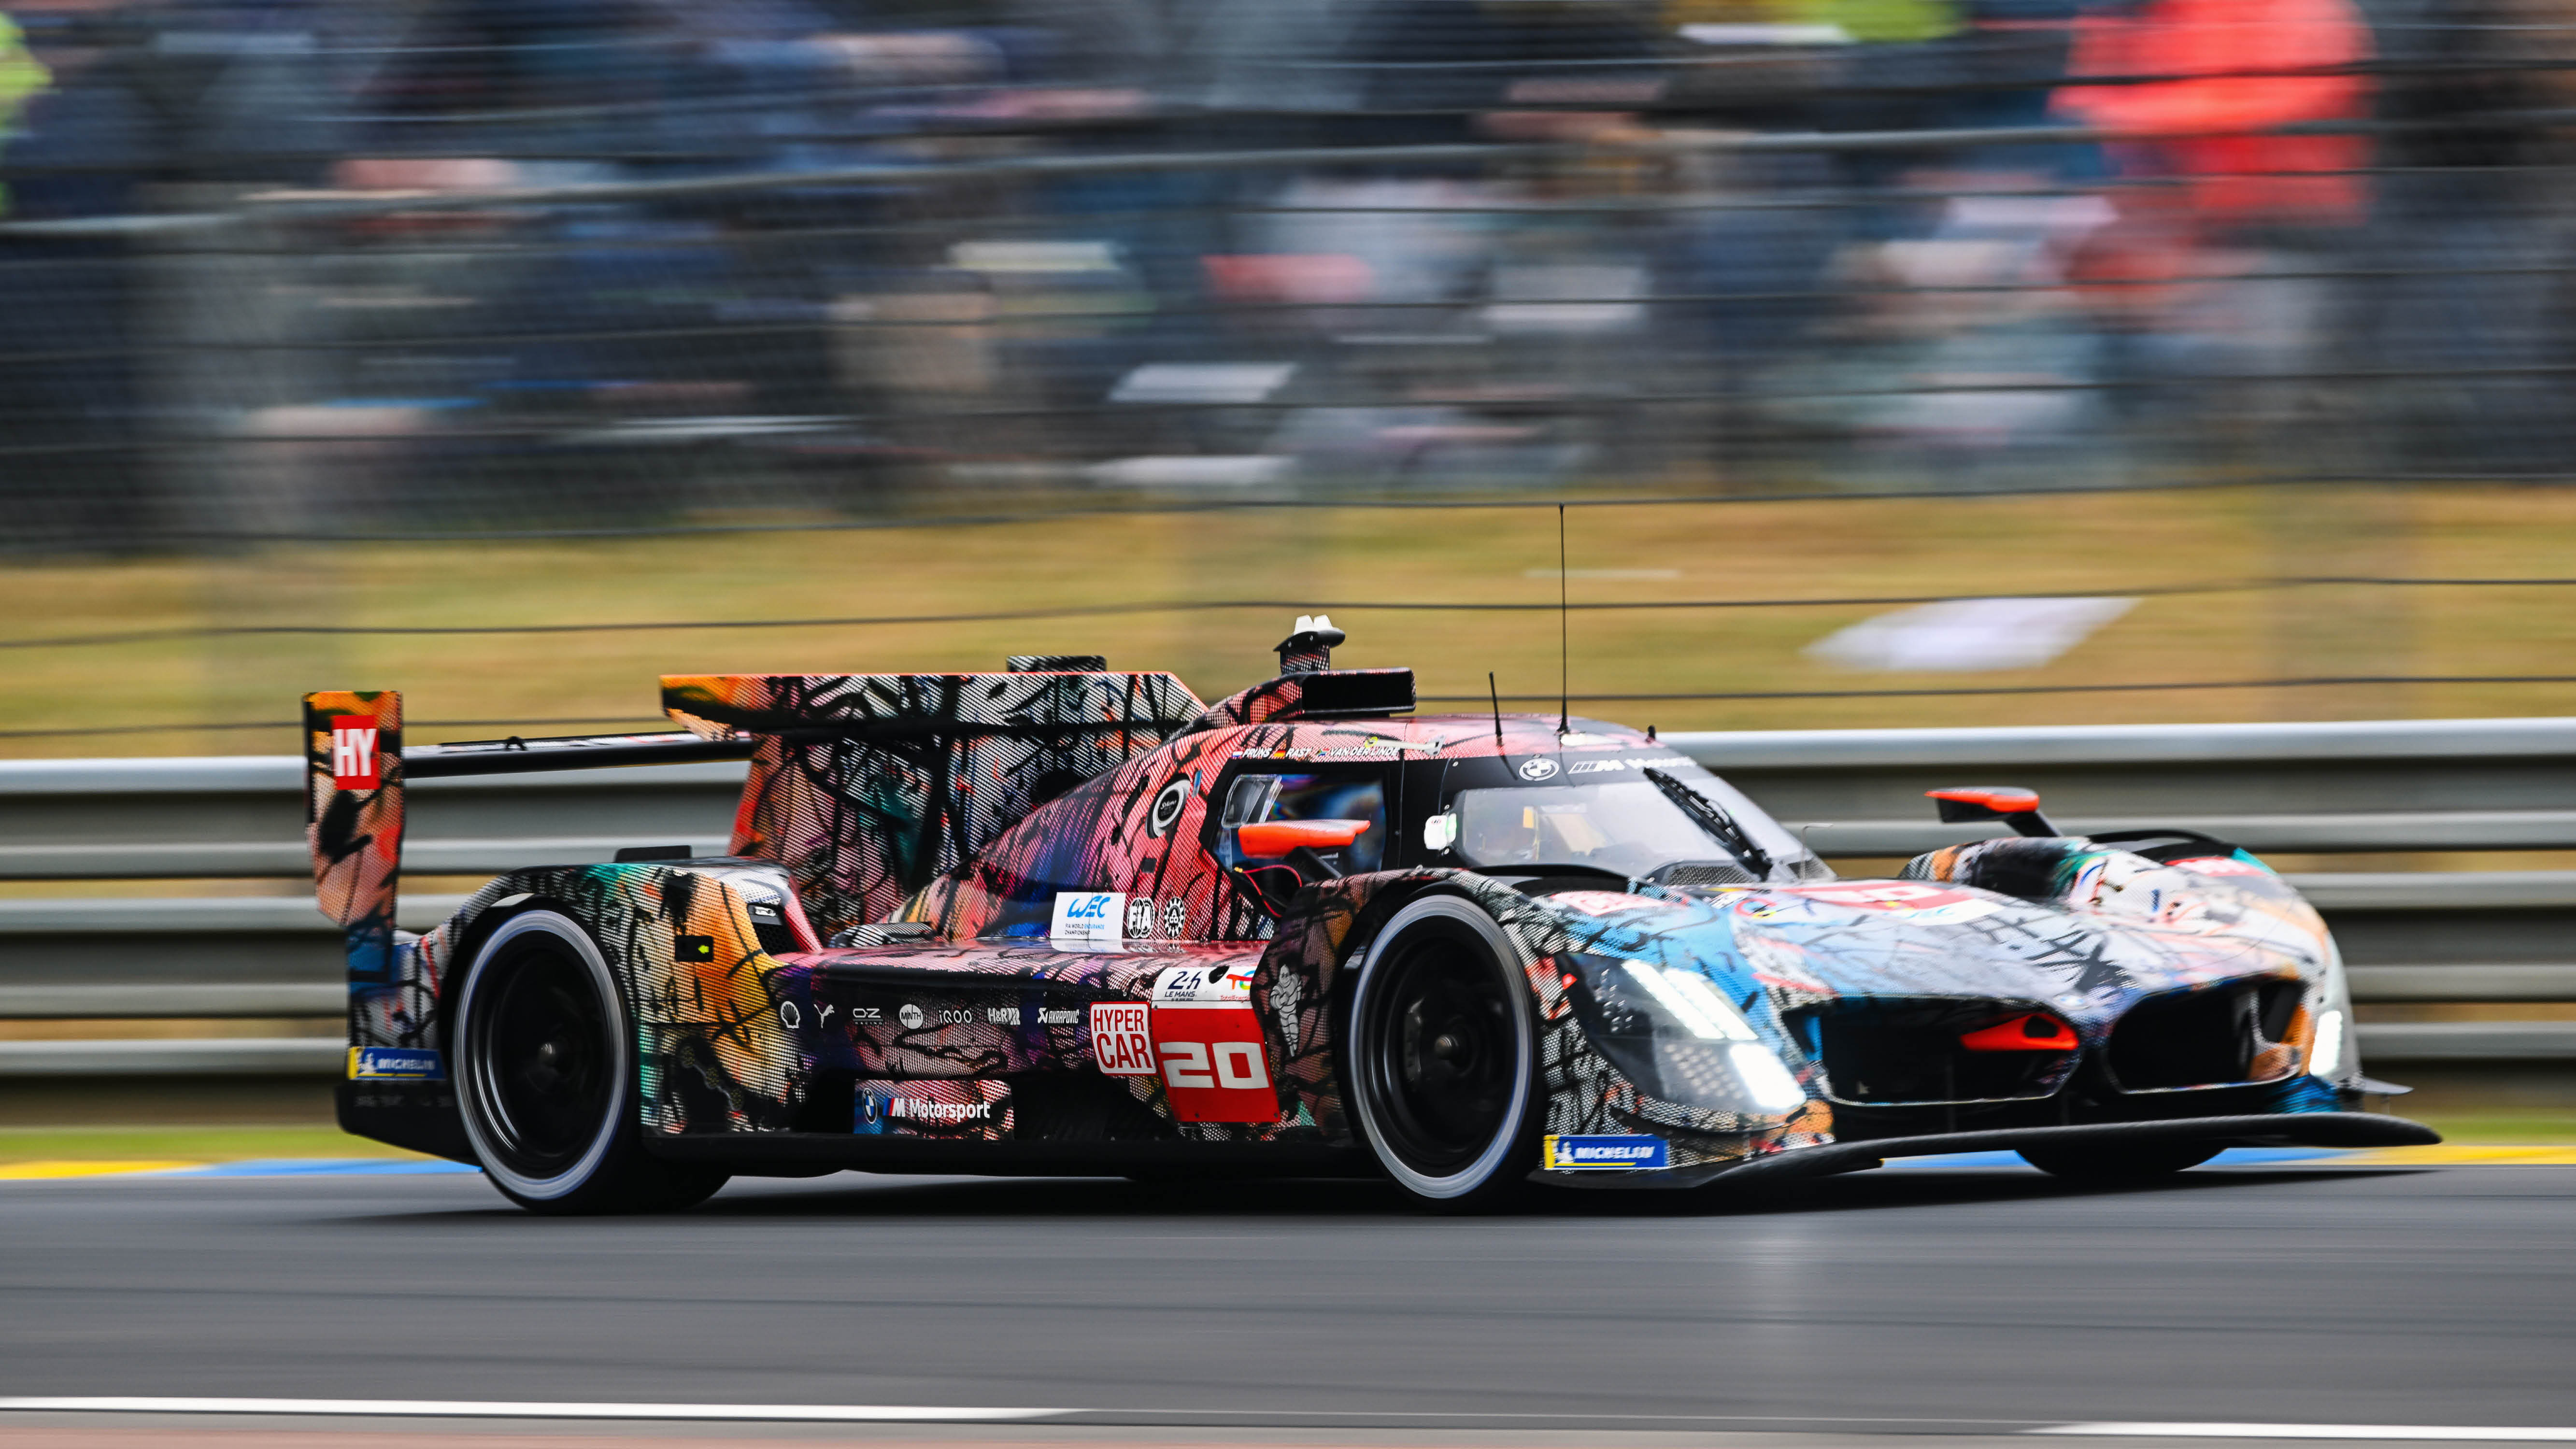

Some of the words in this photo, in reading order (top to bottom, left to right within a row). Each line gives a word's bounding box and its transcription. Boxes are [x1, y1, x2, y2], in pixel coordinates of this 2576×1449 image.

[332, 728, 377, 777] HY
[1285, 748, 1312, 757] RAST
[1330, 747, 1349, 756] VAN
[1350, 747, 1370, 756] DER
[1370, 747, 1400, 756] LINDE
[1067, 895, 1110, 918] WEC
[987, 1008, 1008, 1024] H&R
[1094, 1009, 1144, 1032] HYPER
[1096, 1033, 1153, 1068] CAR
[377, 1058, 435, 1070] MICHELIN
[1159, 1041, 1269, 1089] 20
[910, 1098, 990, 1122] Motorsport
[1575, 1146, 1655, 1159] MICHELIN
